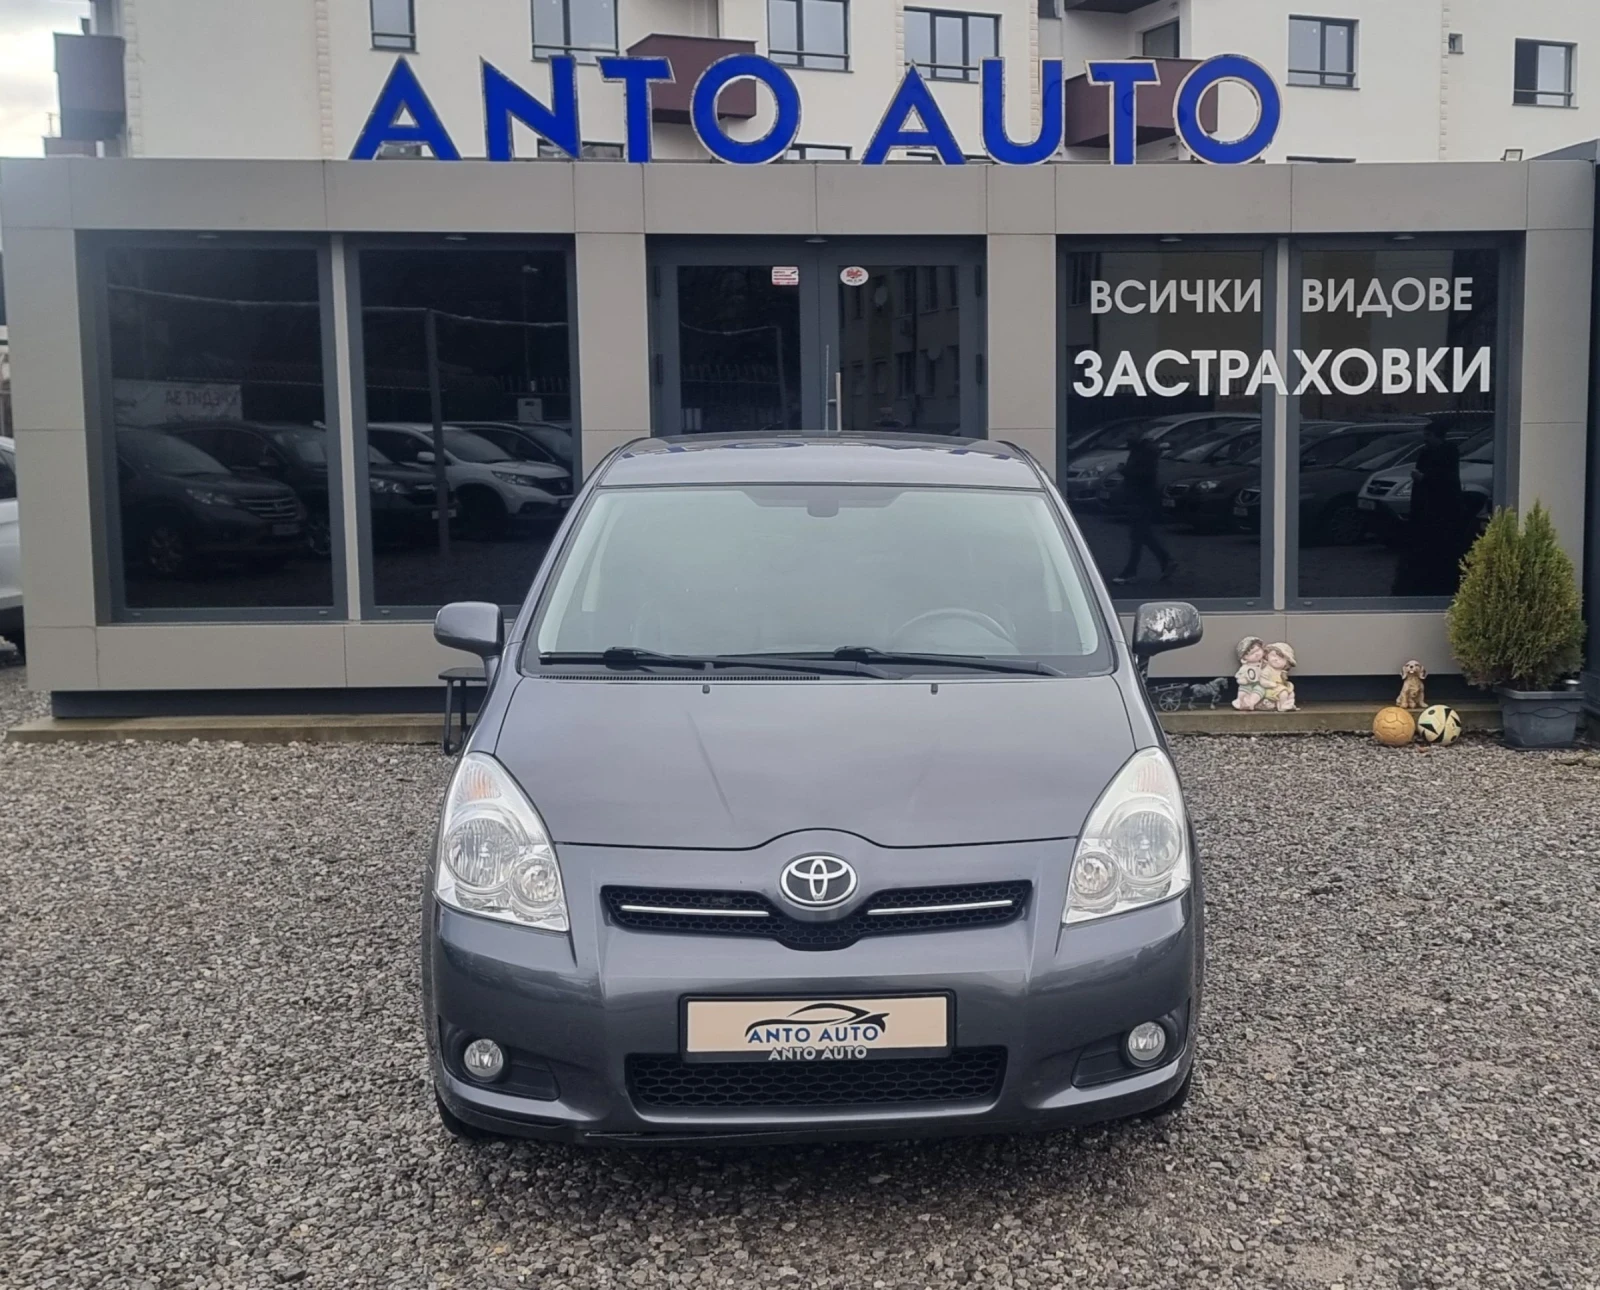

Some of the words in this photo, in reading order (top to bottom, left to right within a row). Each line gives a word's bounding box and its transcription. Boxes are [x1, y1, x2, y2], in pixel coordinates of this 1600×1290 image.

[349, 53, 802, 164] ANTO
[861, 54, 1283, 165] AUTO
[1090, 279, 1261, 314] ВСИЧКИ
[1302, 277, 1473, 318] ВИДОВЕ
[1073, 346, 1491, 397] ЗАСТРАХОВКИ
[748, 1028, 811, 1043] ANTO
[818, 1025, 878, 1042] AUTO
[768, 1047, 816, 1061] ANTO
[820, 1045, 867, 1060] AUTO
